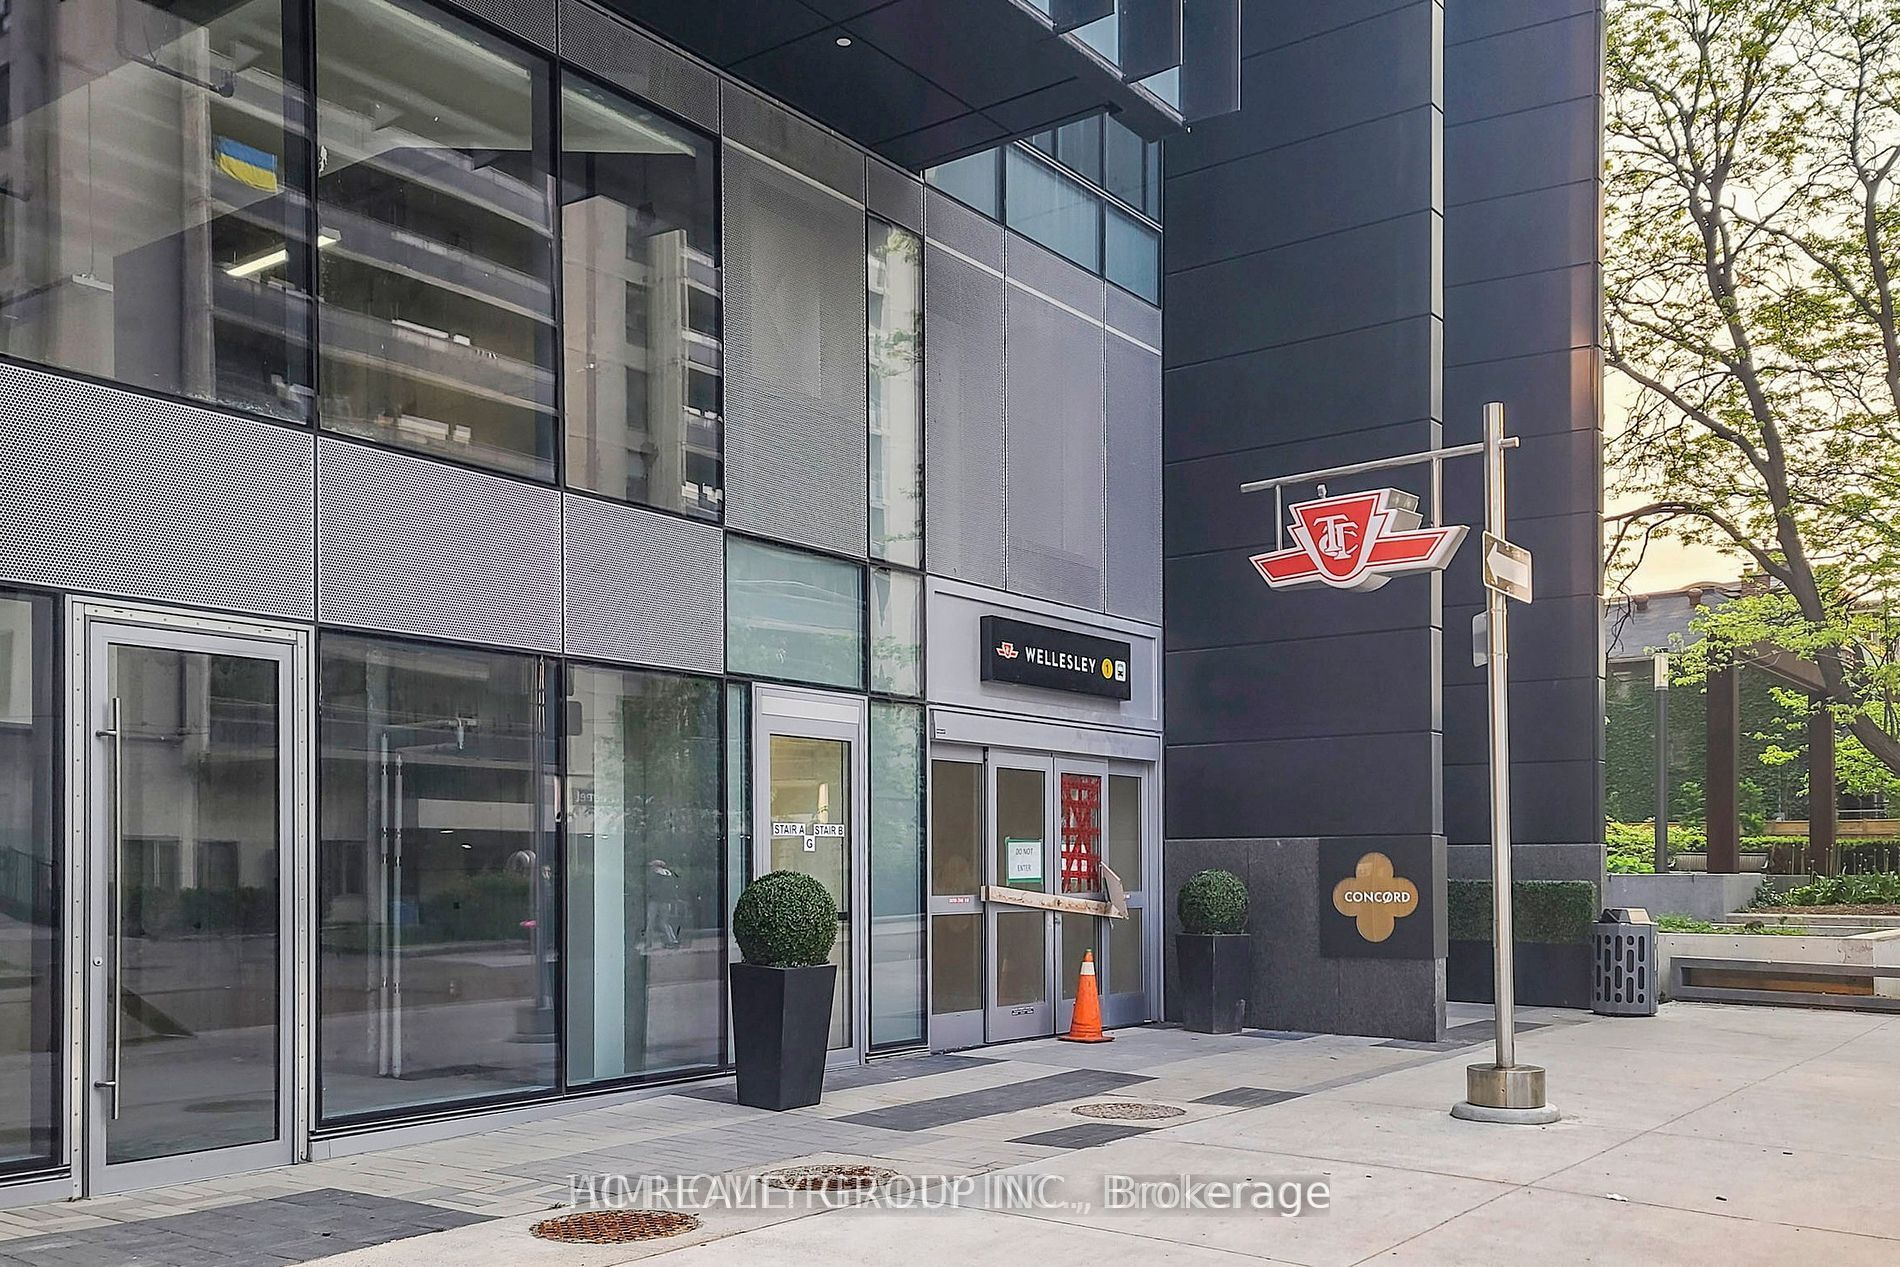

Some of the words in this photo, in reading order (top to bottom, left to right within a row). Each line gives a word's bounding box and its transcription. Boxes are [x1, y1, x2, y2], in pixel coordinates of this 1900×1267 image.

[1025, 646, 1096, 674] WELLESLEY
[774, 824, 797, 834] STAIR
[799, 825, 805, 834] A
[814, 825, 836, 835] STAIR
[838, 826, 844, 835] B
[806, 838, 813, 848] G
